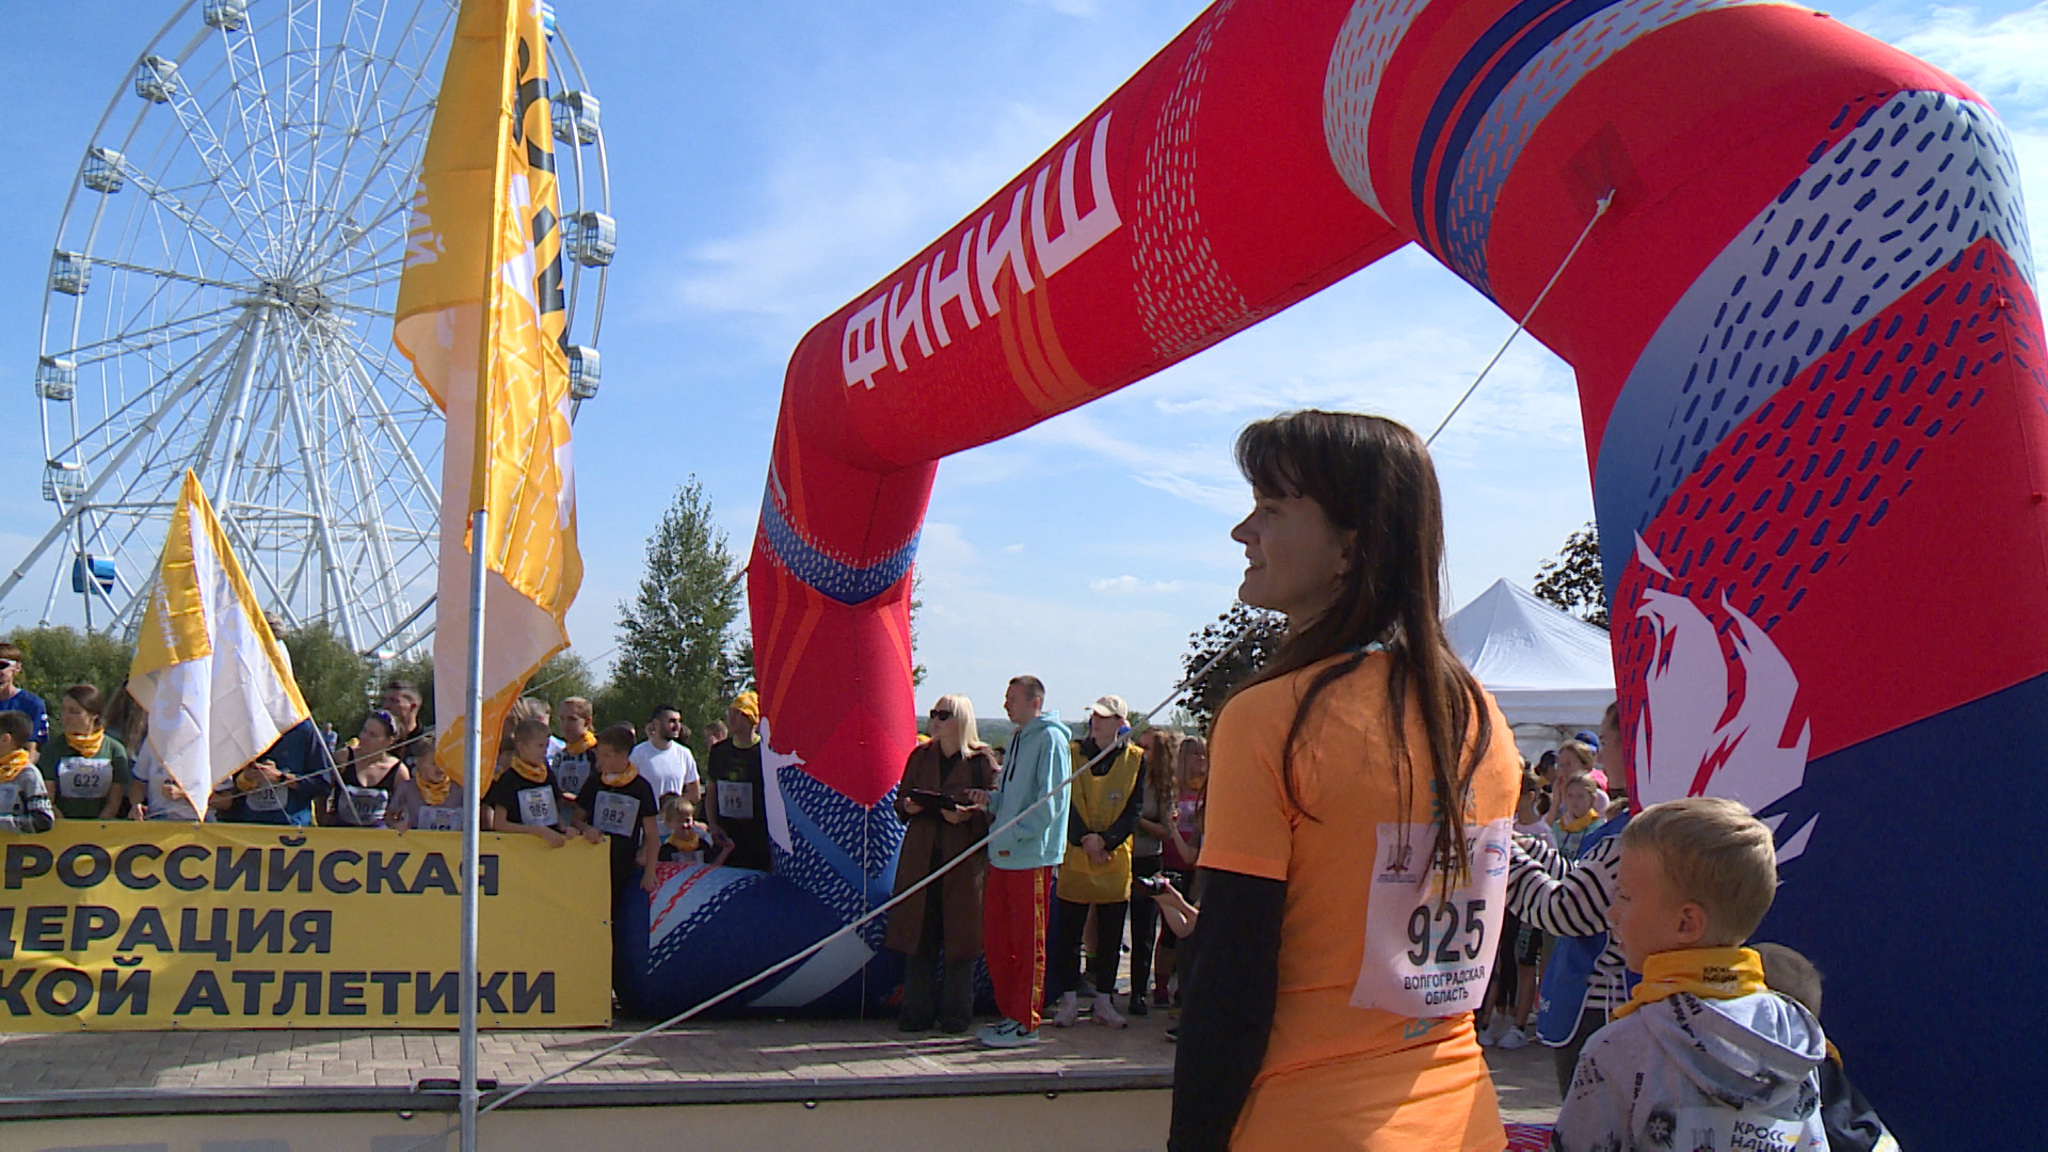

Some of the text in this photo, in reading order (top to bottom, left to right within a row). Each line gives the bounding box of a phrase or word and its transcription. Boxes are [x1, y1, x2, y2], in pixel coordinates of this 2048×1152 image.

[842, 109, 1123, 390] ФИНИШ
[73, 773, 100, 787] 622
[602, 808, 625, 823] 982
[4, 836, 499, 896] РОССИЙСКАЯ
[1407, 900, 1487, 966] 925
[1404, 966, 1486, 990] ВОЛГОГРАДСКАЯ
[173, 970, 556, 1016] АТЛЕТИКИ
[1425, 987, 1469, 1006] ОБЛАСТЬ
[1733, 1121, 1787, 1143] КРОСС
